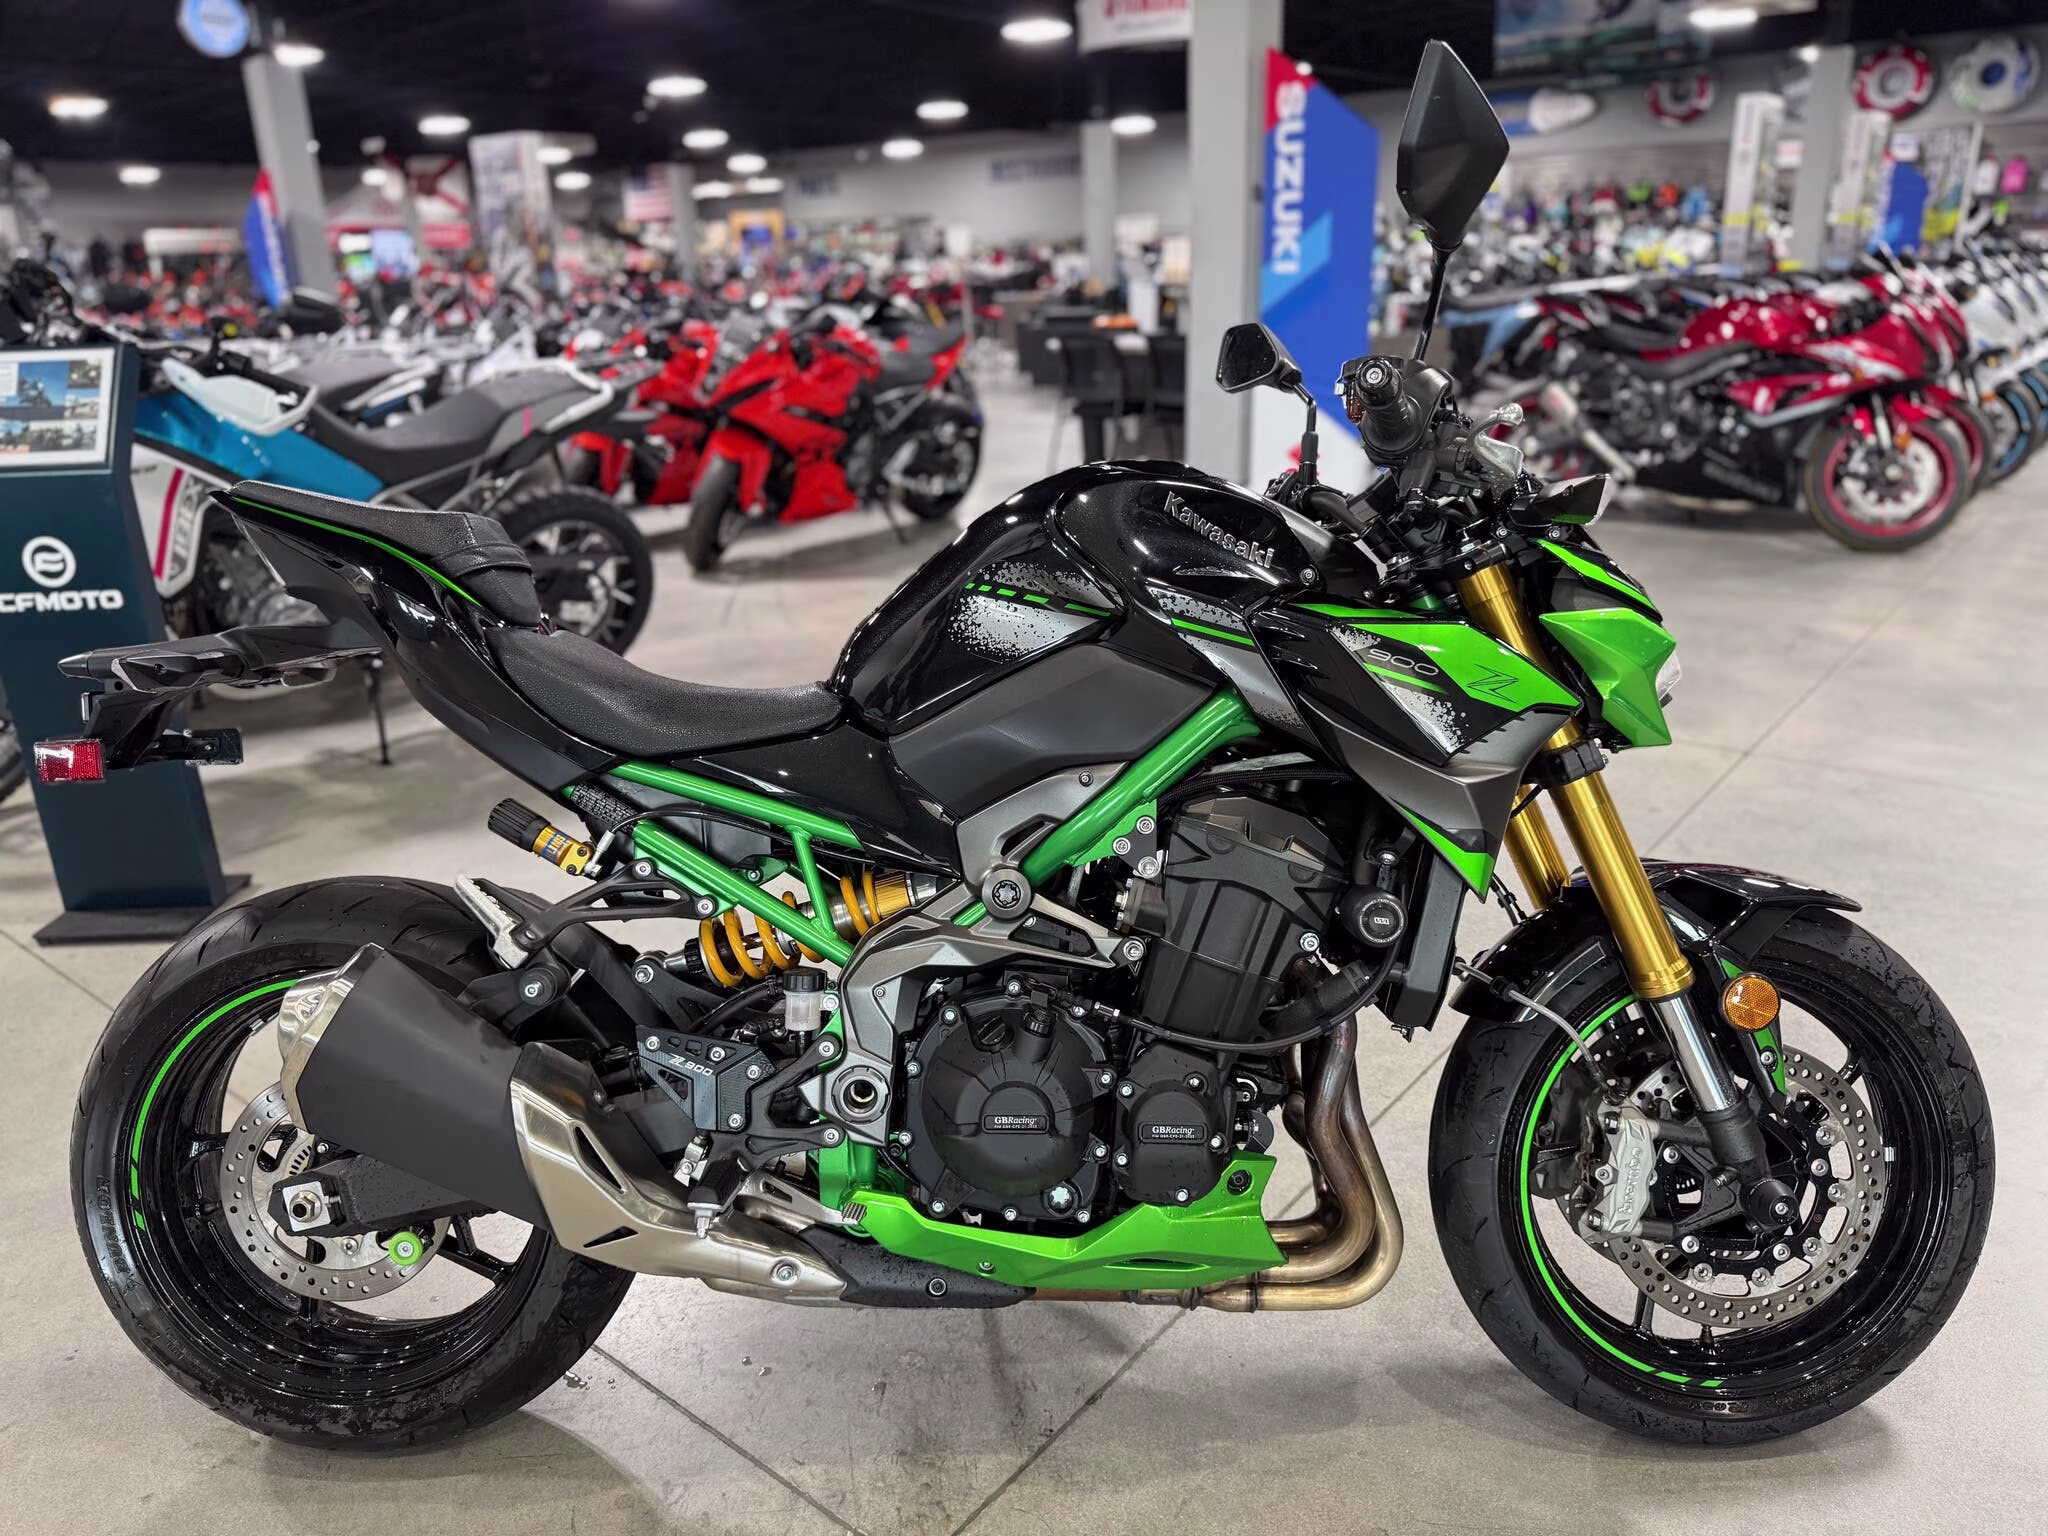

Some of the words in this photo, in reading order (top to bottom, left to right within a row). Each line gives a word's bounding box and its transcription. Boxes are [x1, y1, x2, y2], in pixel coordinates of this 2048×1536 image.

[1272, 81, 1307, 275] SUZUKI
[1163, 490, 1276, 569] Kawasaki
[0, 589, 125, 613] CFMOTO
[1367, 648, 1440, 676] 900
[994, 1116, 1037, 1125] GBRacing
[1152, 1126, 1195, 1135] GBRacing
[1617, 1147, 1643, 1215] brembo
[95, 1174, 131, 1275] DUNLOP
